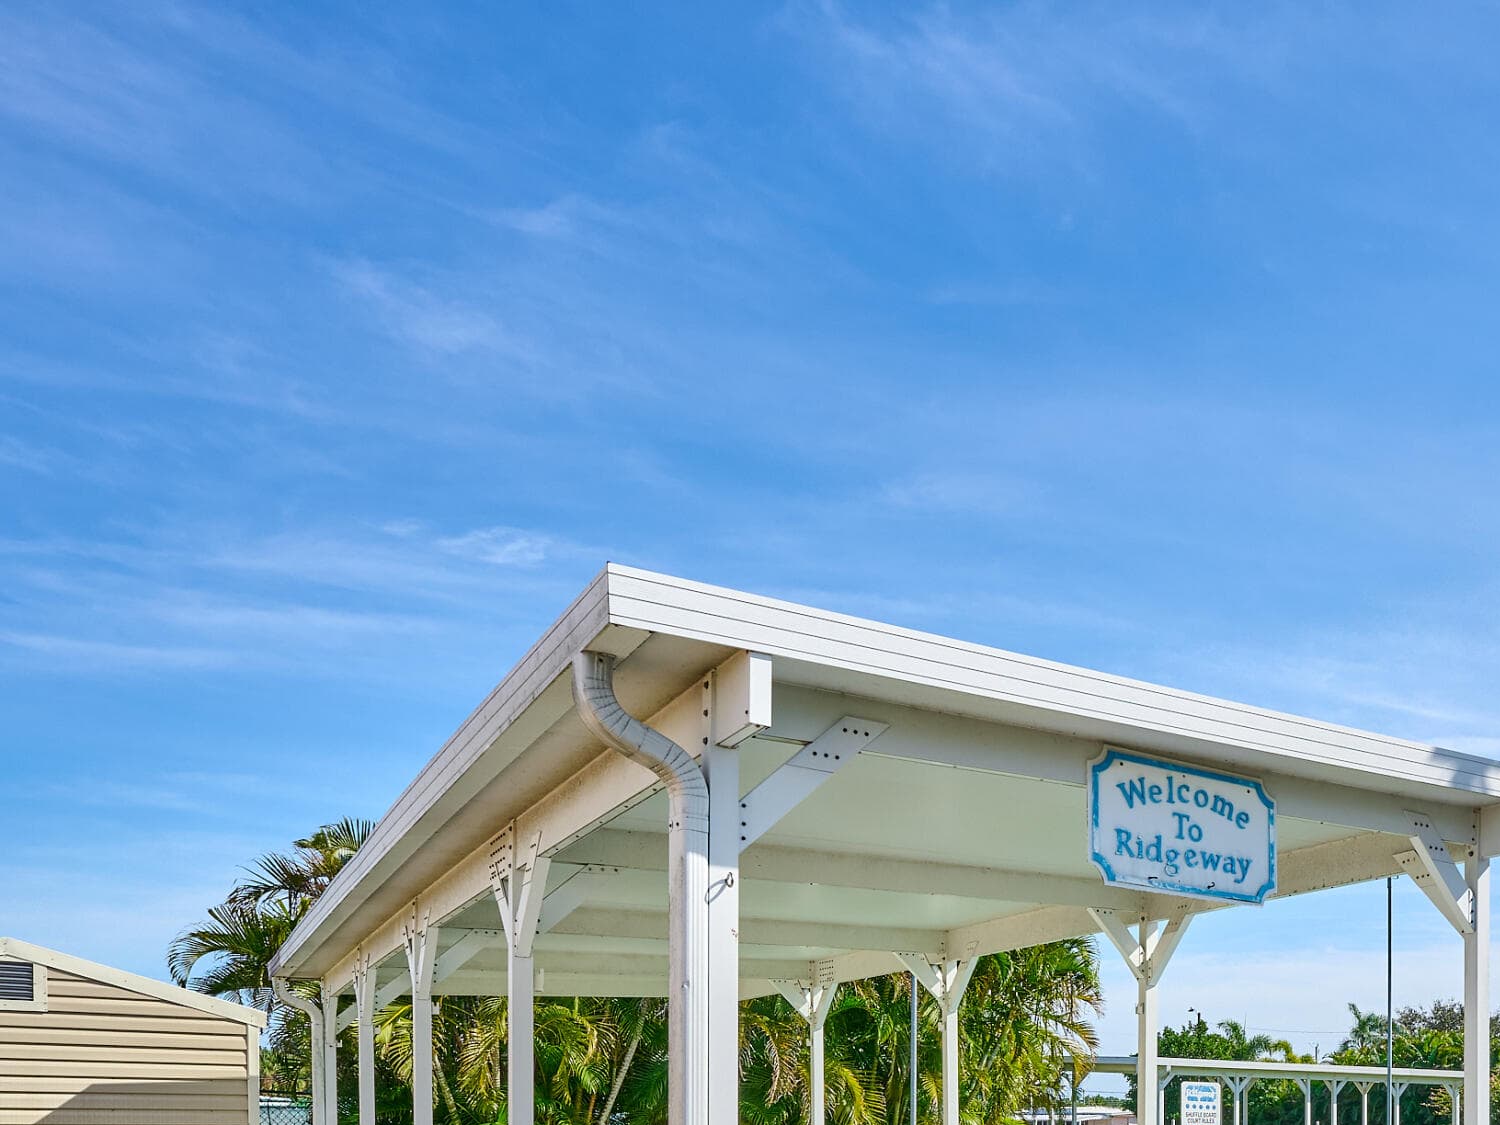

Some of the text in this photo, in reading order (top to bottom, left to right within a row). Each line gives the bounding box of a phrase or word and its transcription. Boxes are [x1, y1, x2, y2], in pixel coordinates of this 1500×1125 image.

[1116, 776, 1250, 829] Welcome
[1173, 812, 1203, 842] To
[1114, 828, 1253, 884] Ridgeway
